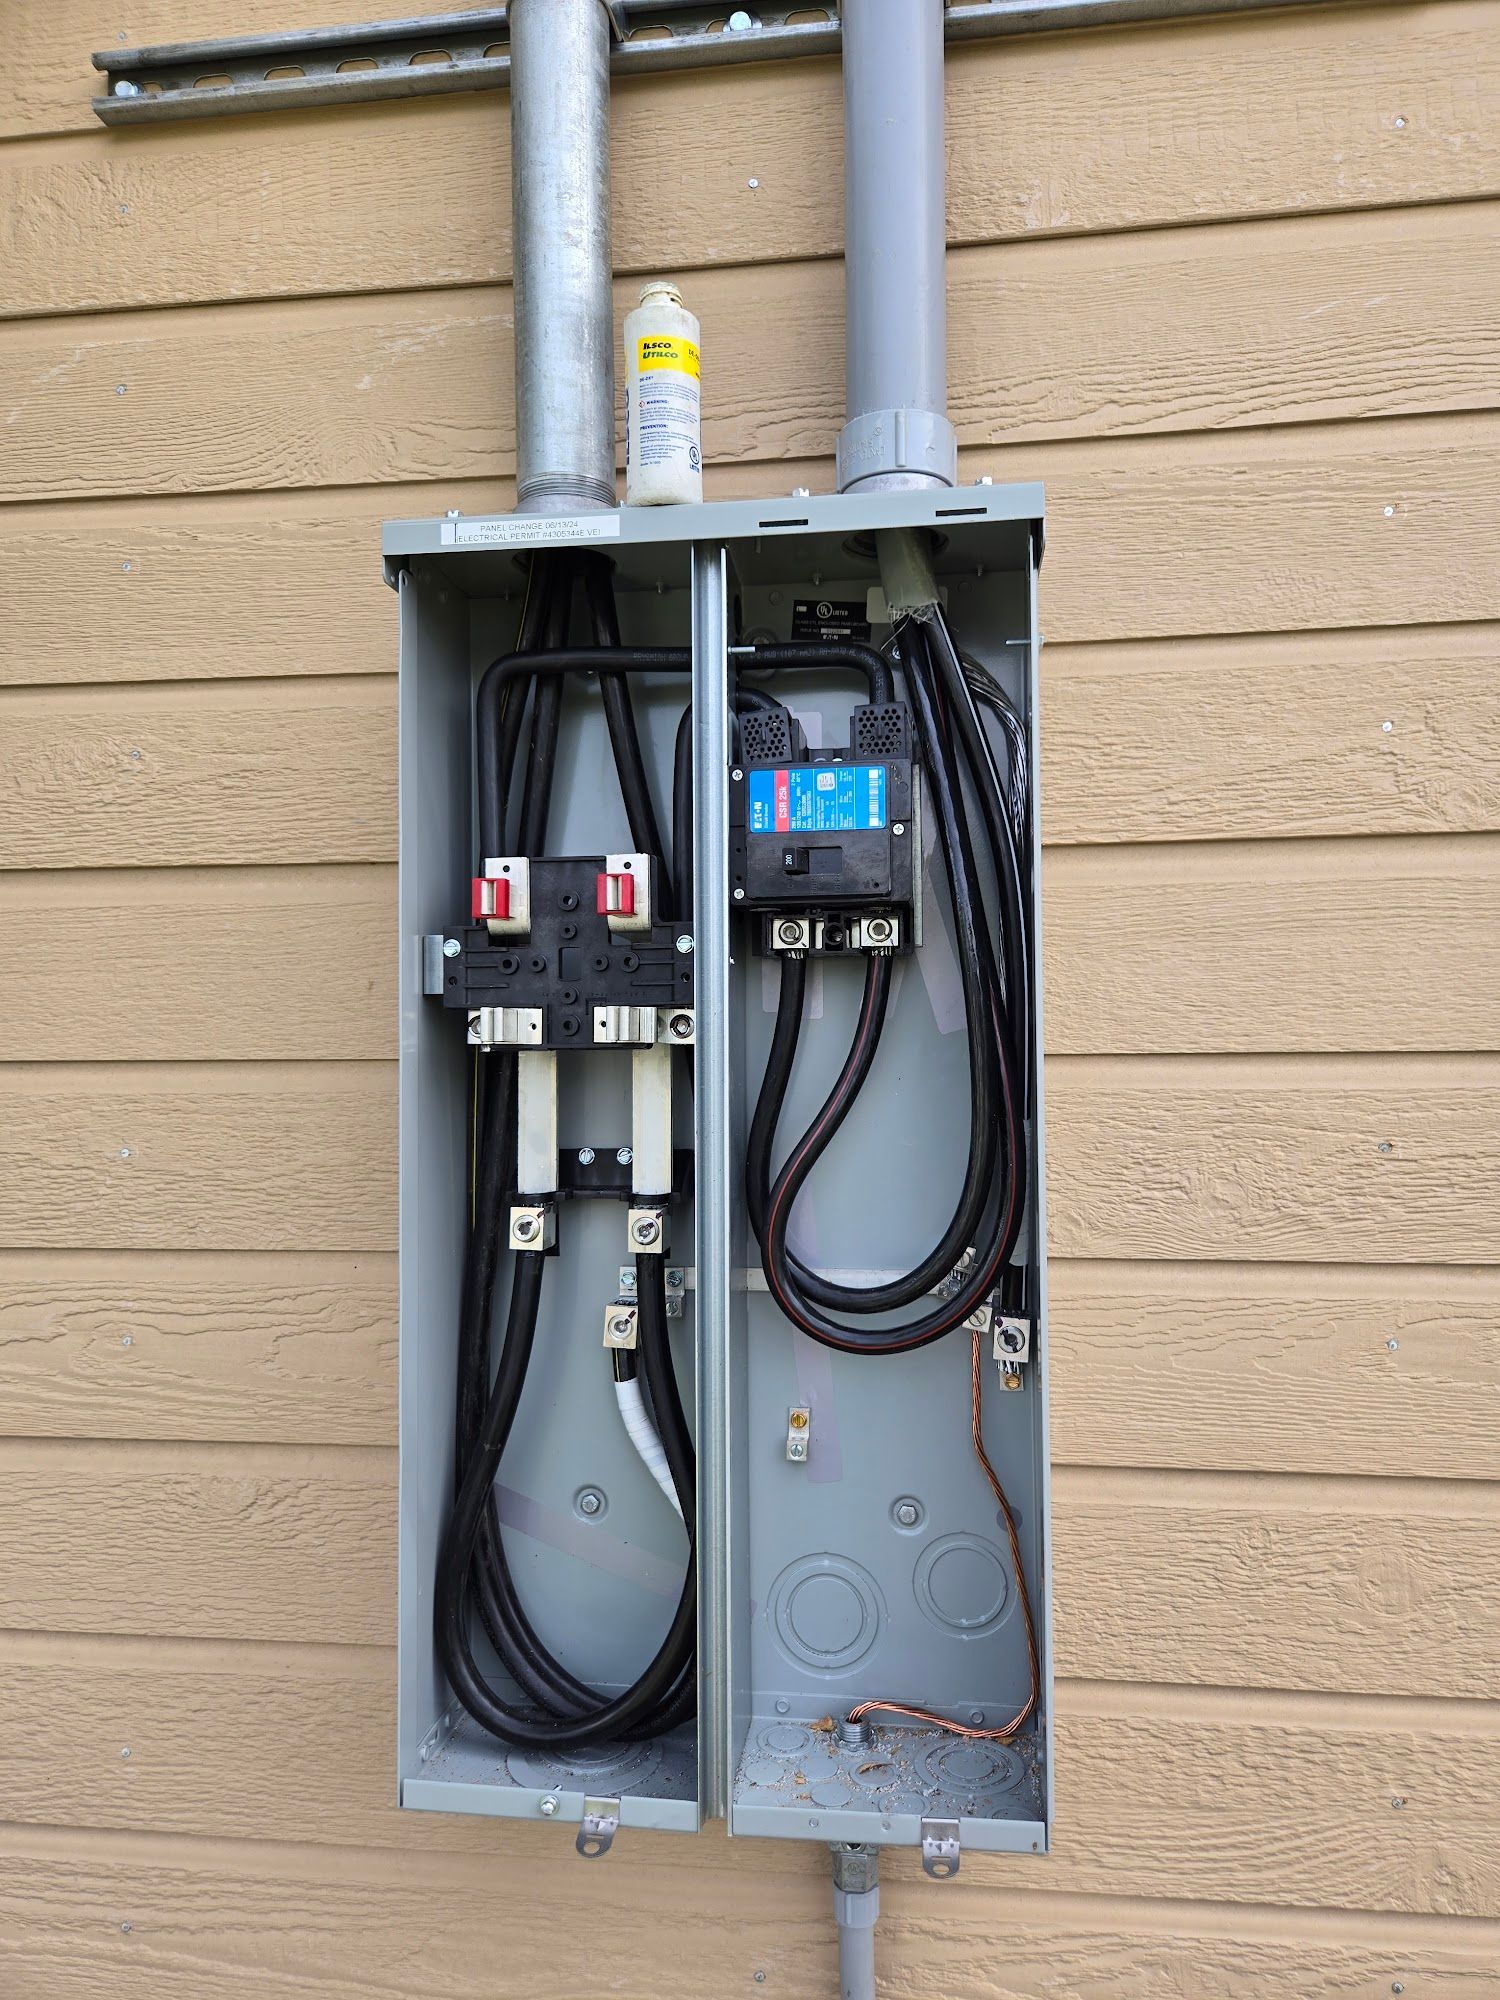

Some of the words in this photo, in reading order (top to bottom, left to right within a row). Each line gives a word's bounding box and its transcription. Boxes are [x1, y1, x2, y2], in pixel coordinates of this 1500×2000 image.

[643, 342, 672, 350] ILSCO
[642, 351, 678, 359] UTILCO
[480, 524, 508, 532] PANEL
[508, 522, 543, 531] CHANGE
[458, 533, 507, 543] ELECTRICAL
[510, 531, 540, 541] PERMIT
[778, 785, 788, 801] 25k
[778, 801, 788, 819] CSR
[785, 854, 793, 865] 200
